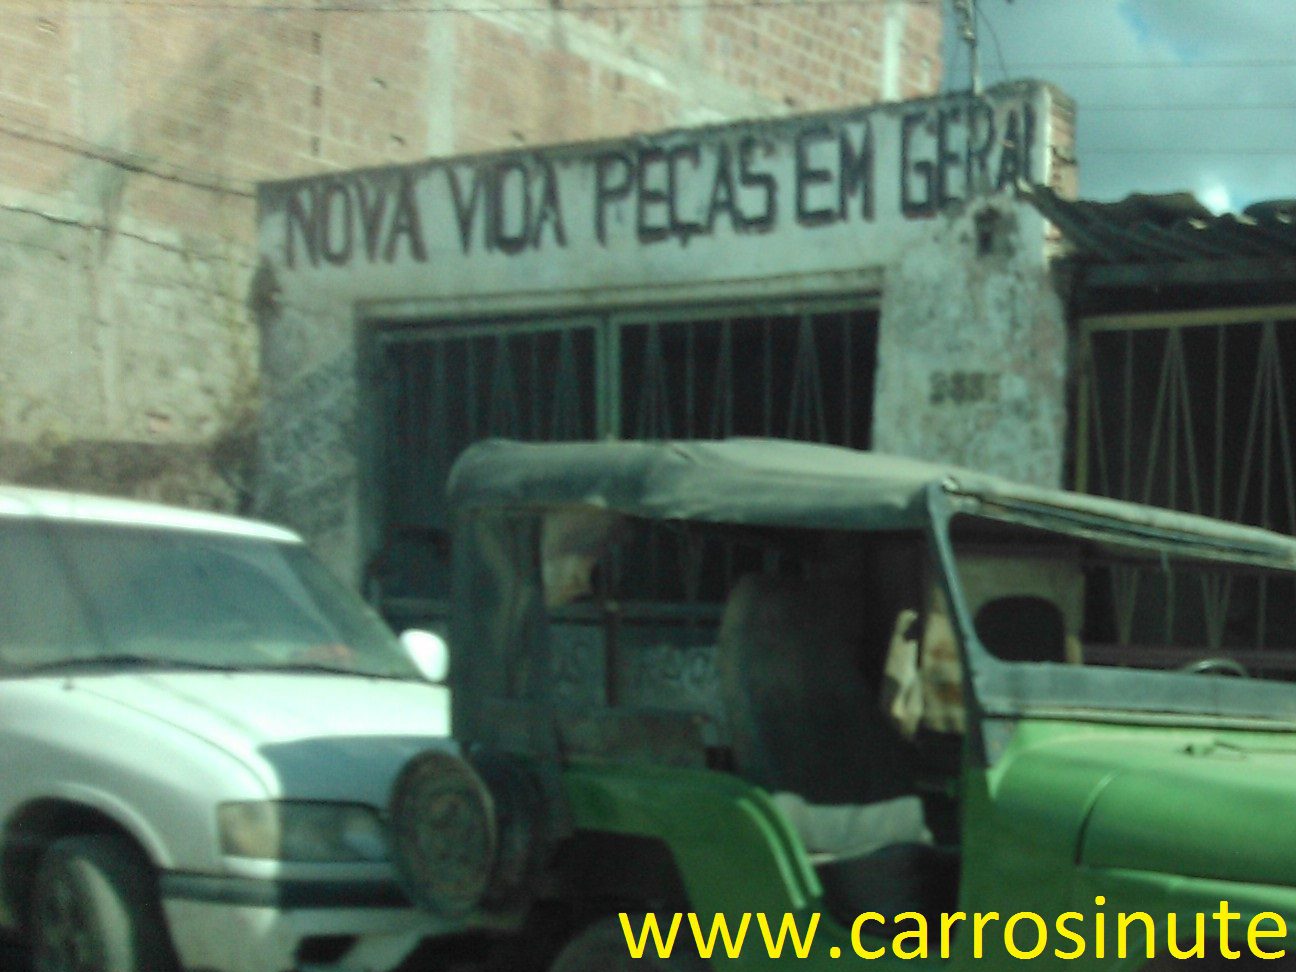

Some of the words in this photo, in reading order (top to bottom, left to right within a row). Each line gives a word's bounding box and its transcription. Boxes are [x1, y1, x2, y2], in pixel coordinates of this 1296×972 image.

[285, 180, 428, 269] NOVA
[446, 155, 567, 255] VIDA
[594, 132, 778, 249] PEÇAS
[795, 118, 875, 228] EM
